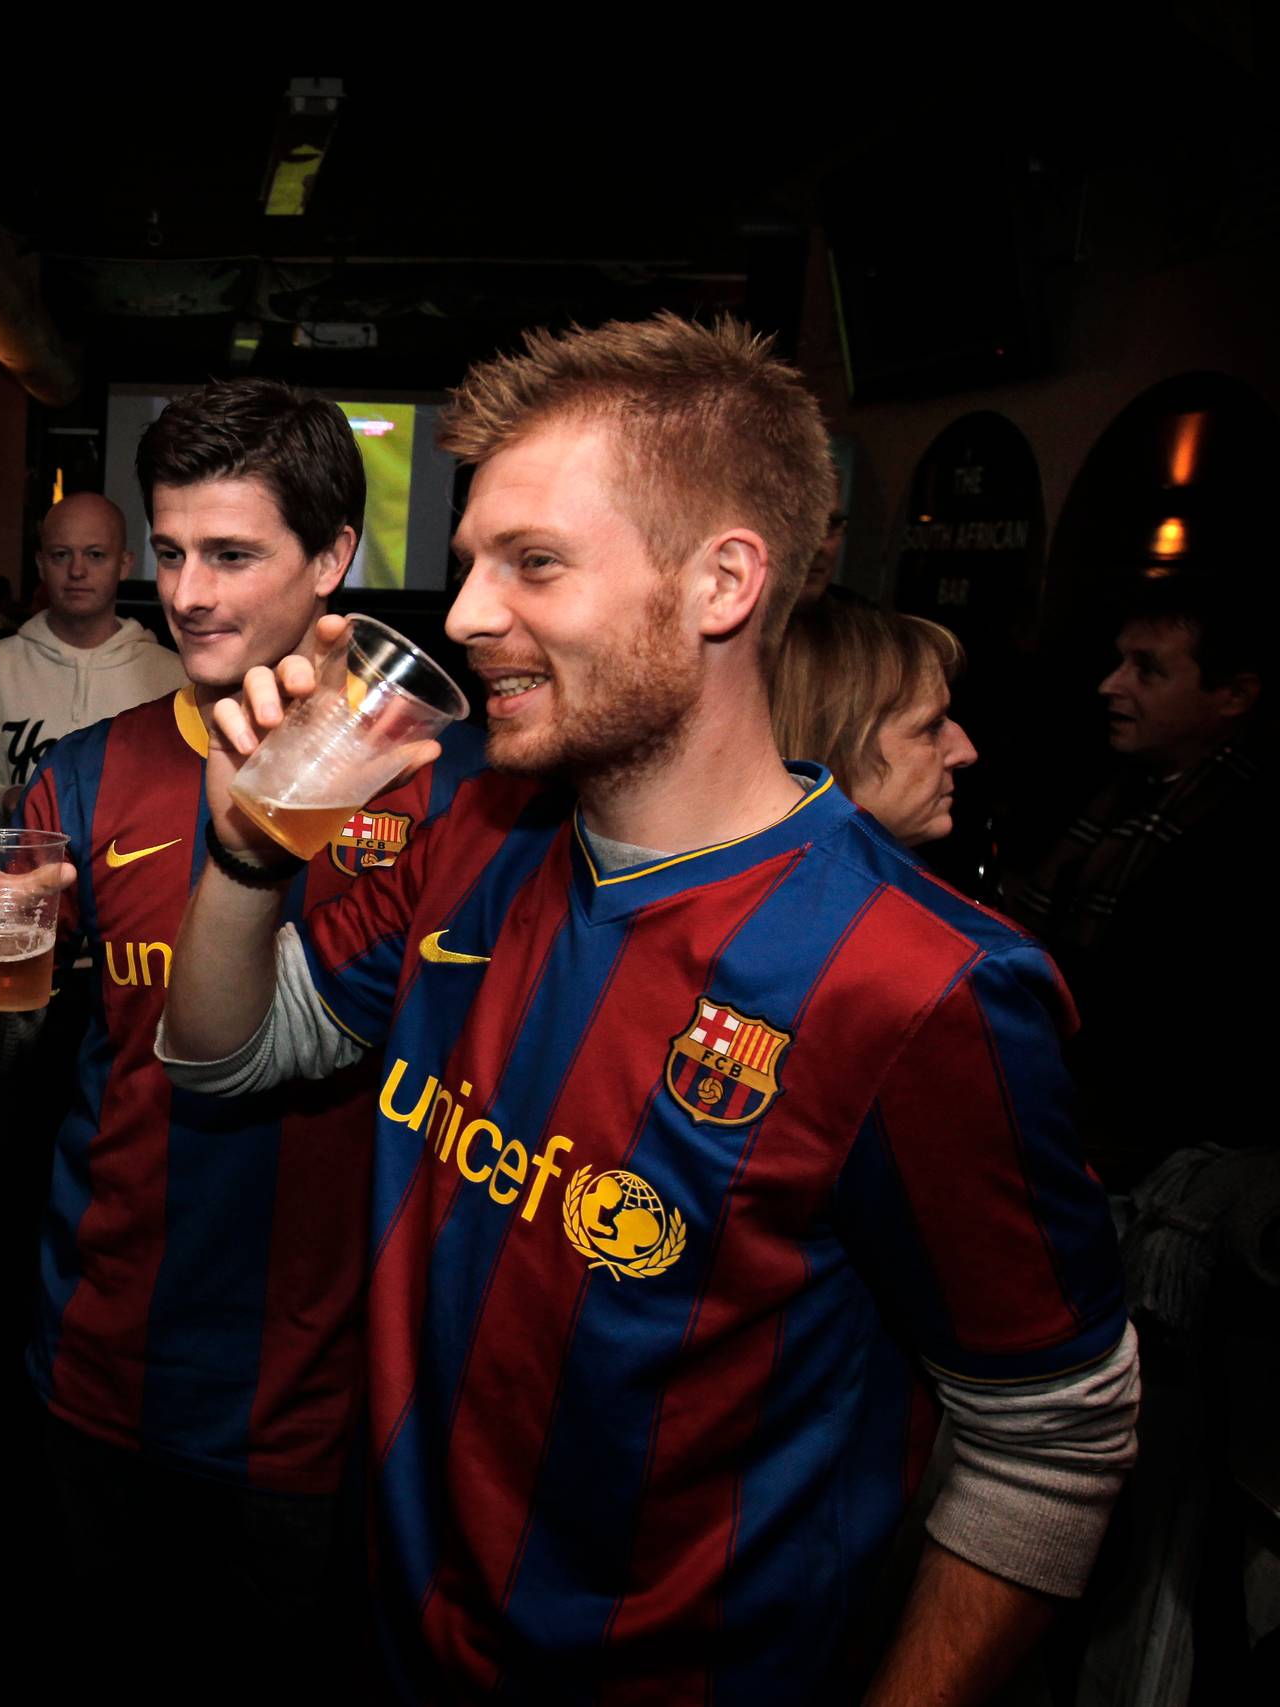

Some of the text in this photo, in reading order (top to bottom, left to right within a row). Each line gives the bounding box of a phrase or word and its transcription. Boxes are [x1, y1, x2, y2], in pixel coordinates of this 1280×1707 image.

[952, 464, 985, 496] THE
[954, 519, 1031, 551] AFRICAN
[935, 574, 970, 607] BAR
[355, 838, 386, 850] FCB
[701, 1049, 743, 1078] FCB
[378, 1057, 575, 1223] unicef
